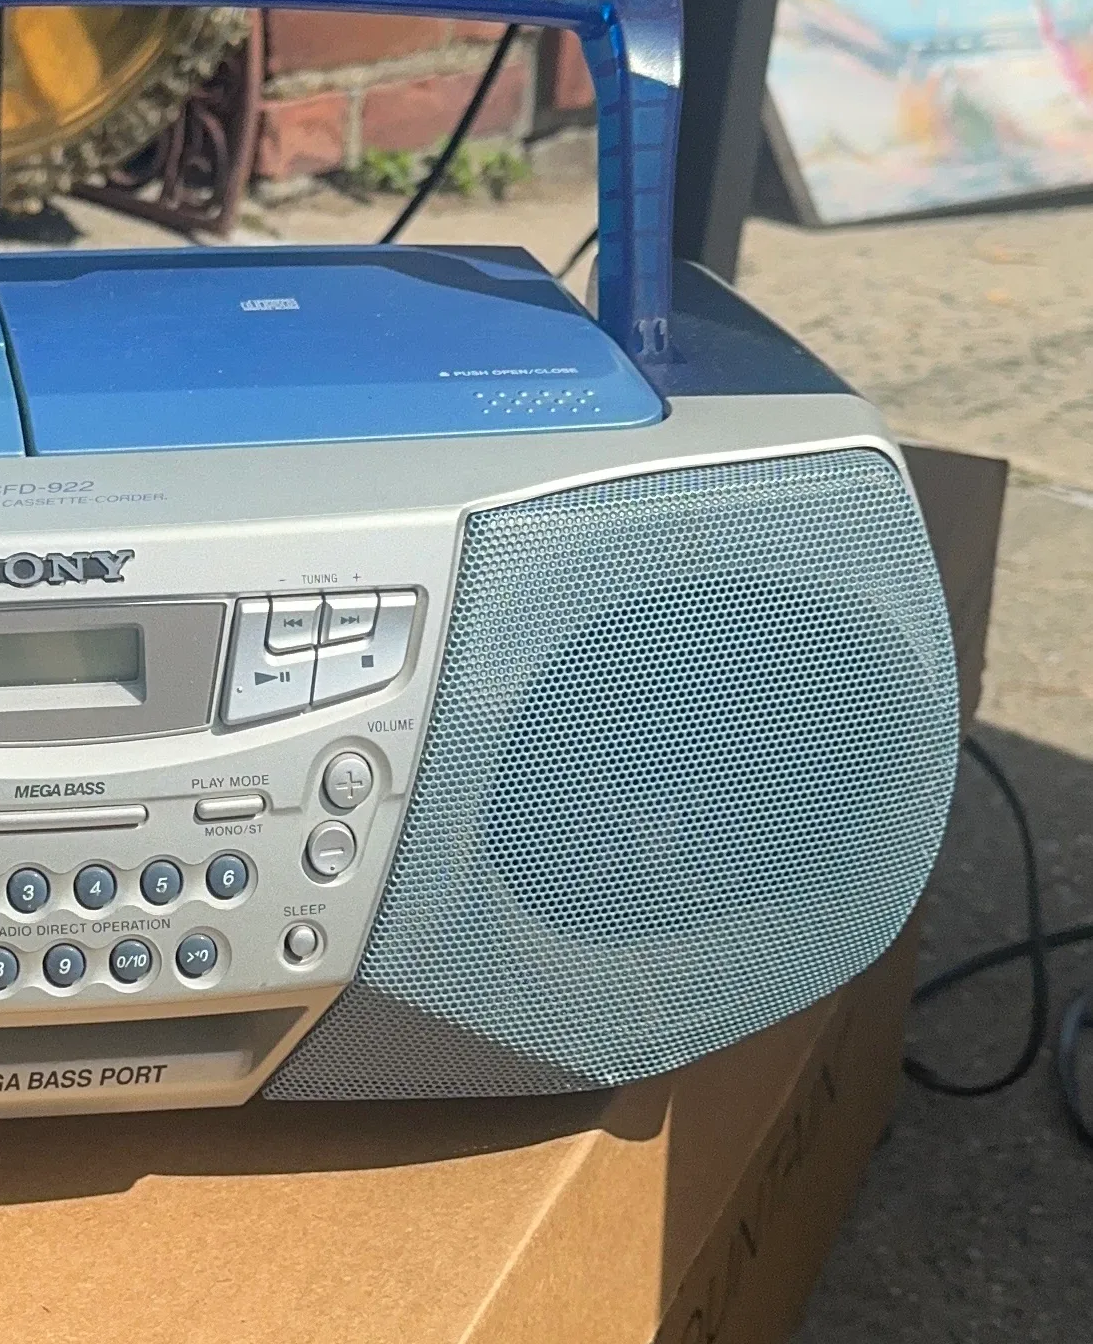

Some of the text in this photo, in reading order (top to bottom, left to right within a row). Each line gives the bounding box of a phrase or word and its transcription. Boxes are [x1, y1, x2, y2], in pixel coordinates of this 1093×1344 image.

[492, 367, 579, 376] OPEN/CLOSE
[301, 573, 338, 585] TUNING
[367, 718, 415, 733] VOLUME
[191, 775, 270, 789] PLAY MODE
[14, 782, 105, 799] MEGA BASS
[204, 824, 263, 837] MONO/ST
[22, 885, 35, 900] 3
[89, 880, 102, 897] 4
[156, 877, 168, 893] 5
[223, 870, 235, 886] 6
[283, 903, 327, 917] SLEEP
[37, 922, 87, 936] DIRECT
[91, 918, 171, 933] OPERATION
[59, 958, 71, 975] 9
[116, 954, 147, 969] 0/10
[27, 1068, 92, 1090] BASS
[99, 1064, 168, 1087] PORT
